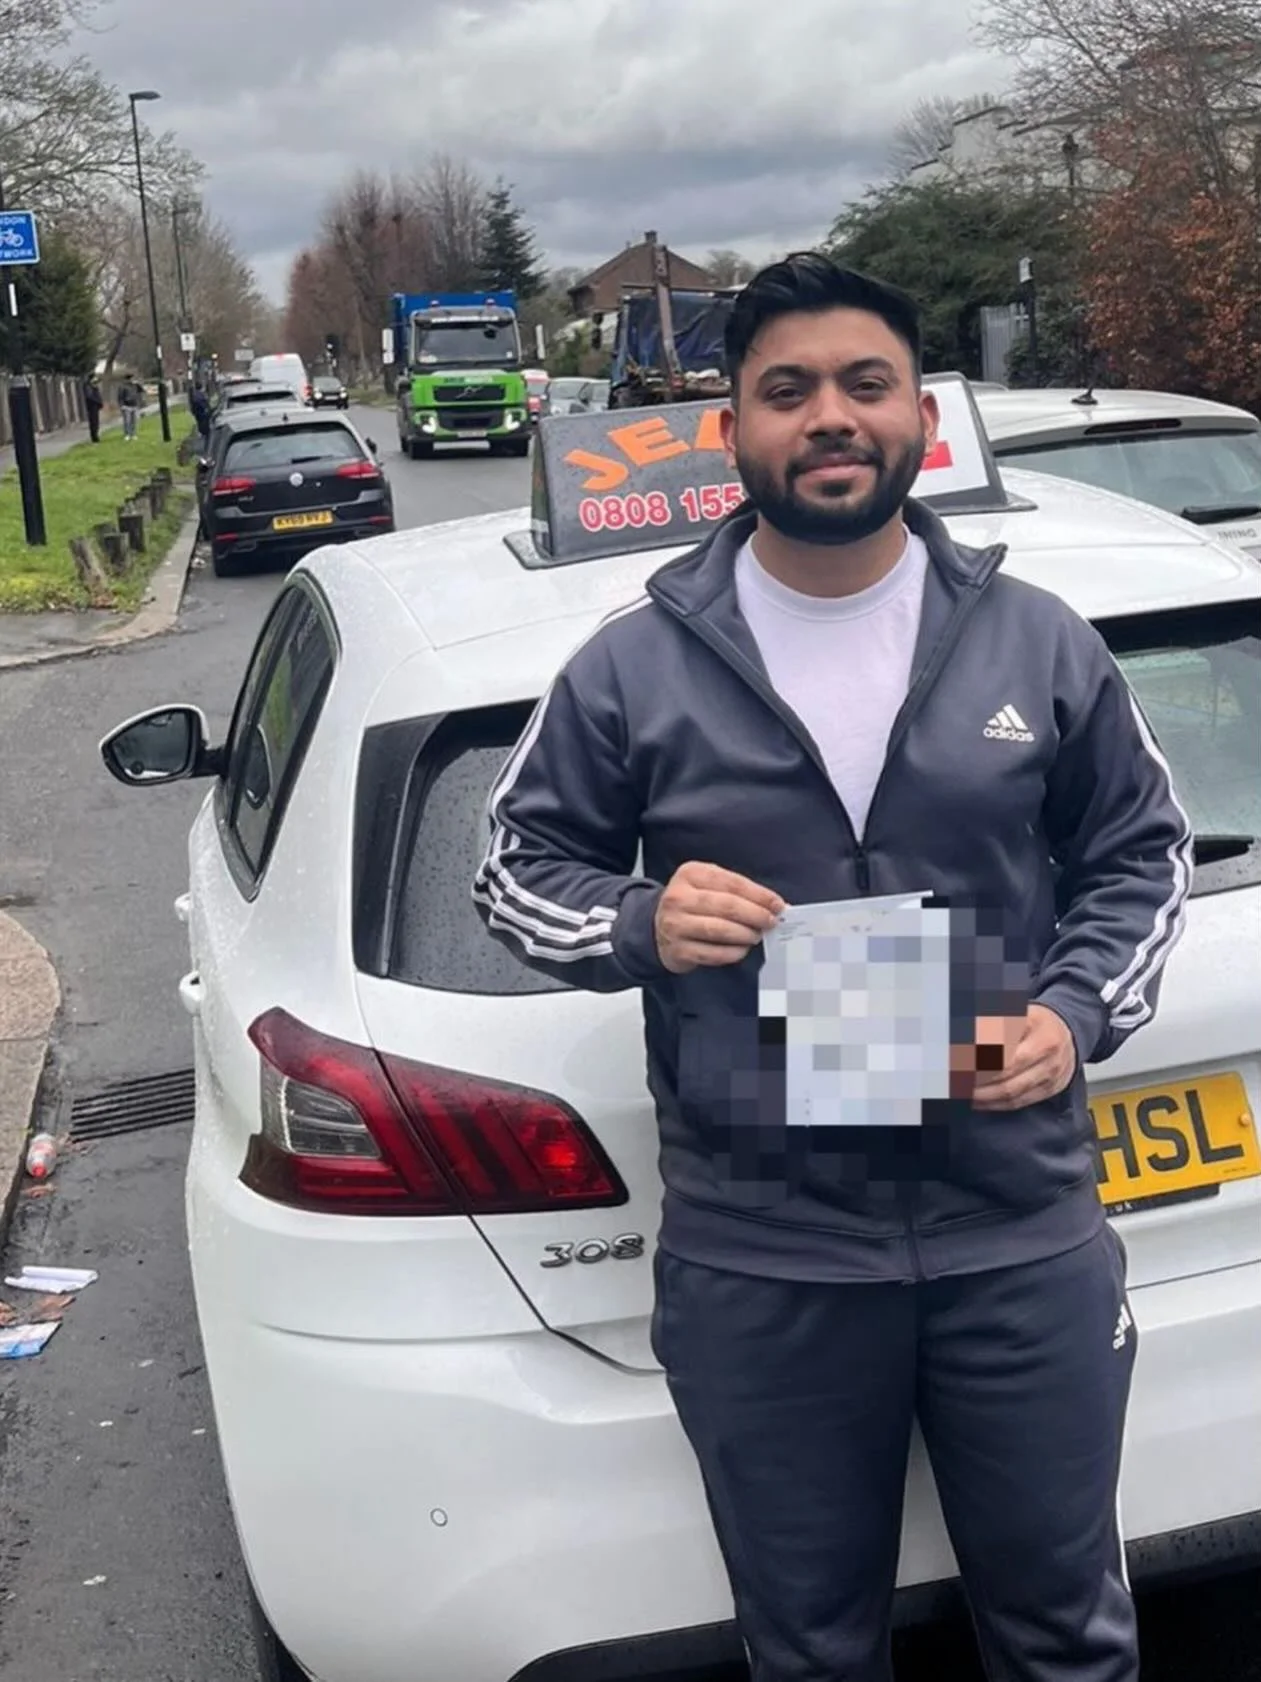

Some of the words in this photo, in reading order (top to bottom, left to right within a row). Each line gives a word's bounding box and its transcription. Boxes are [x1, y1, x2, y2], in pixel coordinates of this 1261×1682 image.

[579, 491, 671, 532] 0808
[983, 726, 1035, 743] adidas
[1089, 1089, 1244, 1183] HSL
[540, 1231, 645, 1268] 308
